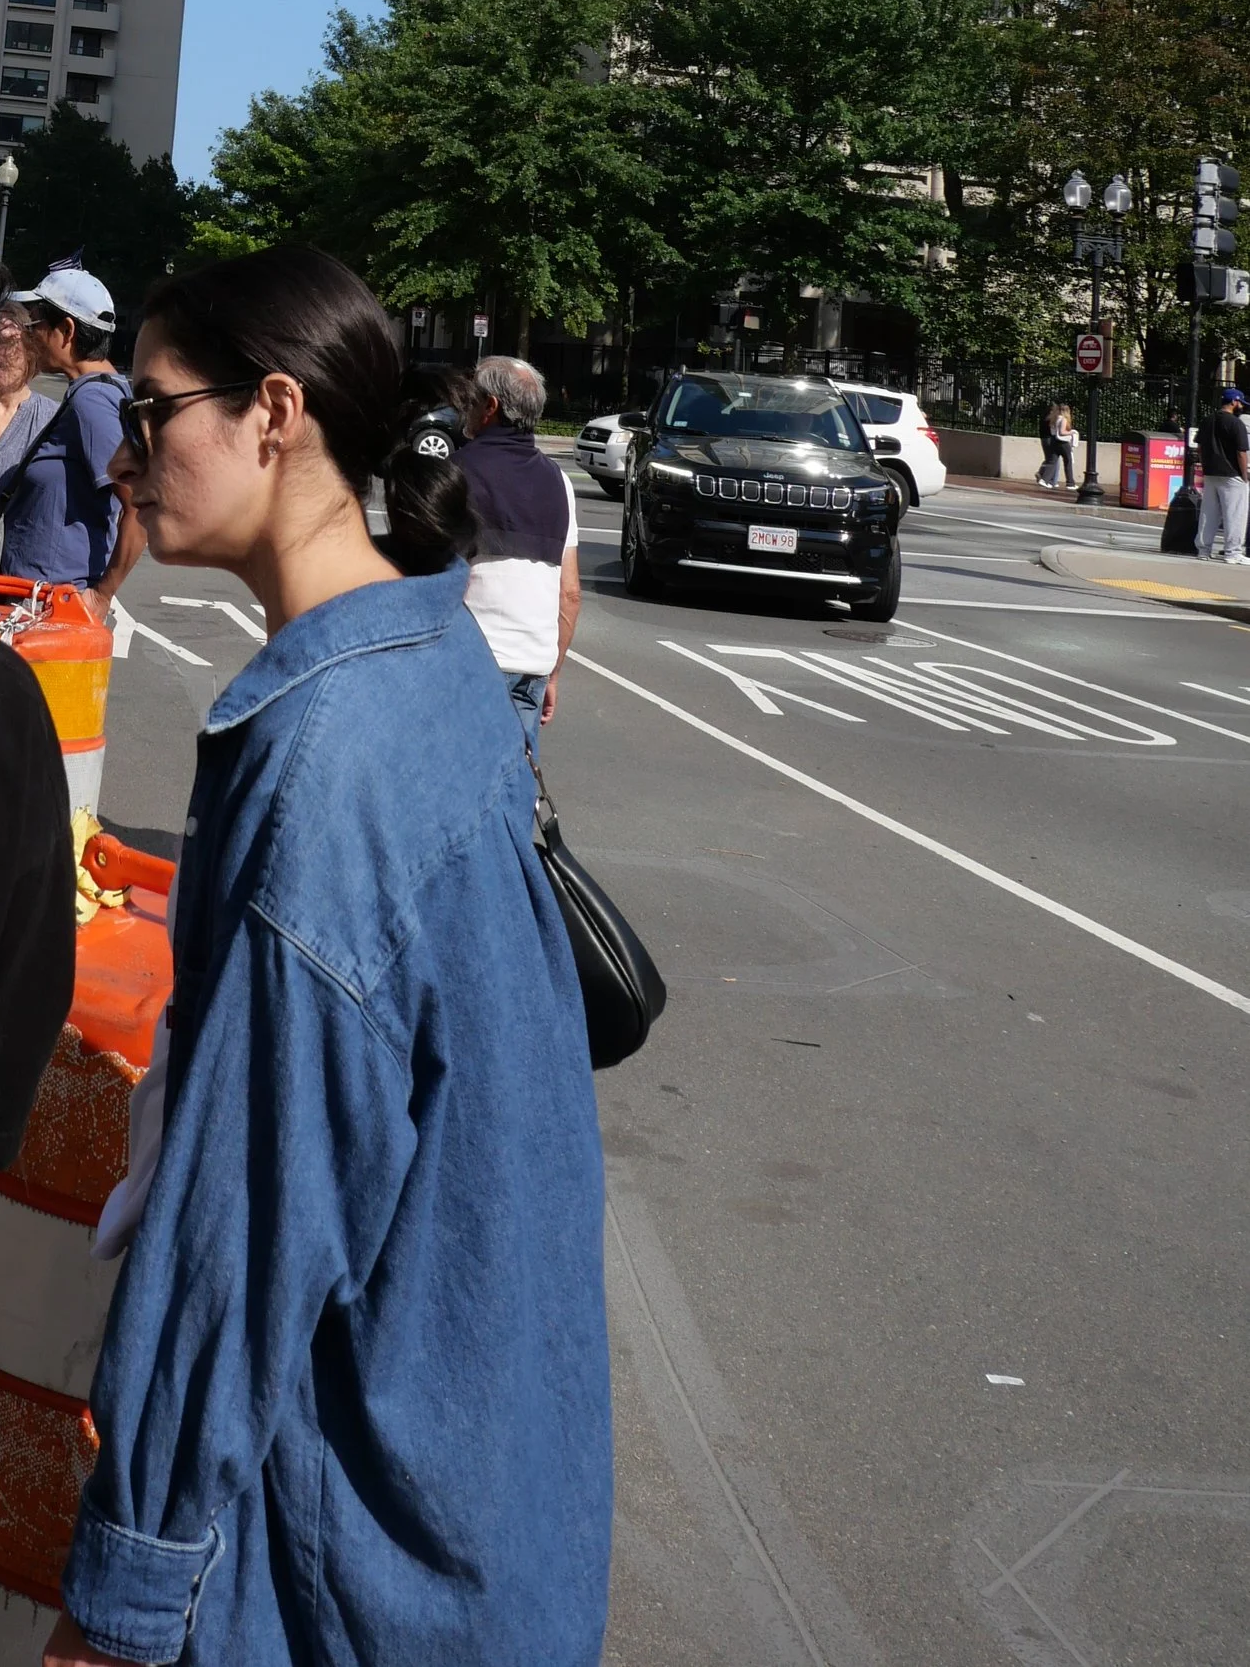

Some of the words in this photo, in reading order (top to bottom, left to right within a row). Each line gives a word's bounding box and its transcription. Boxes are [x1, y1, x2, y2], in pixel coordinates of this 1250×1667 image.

[763, 472, 784, 481] Jeep
[751, 532, 778, 546] 2MCW
[781, 534, 794, 548] 98
